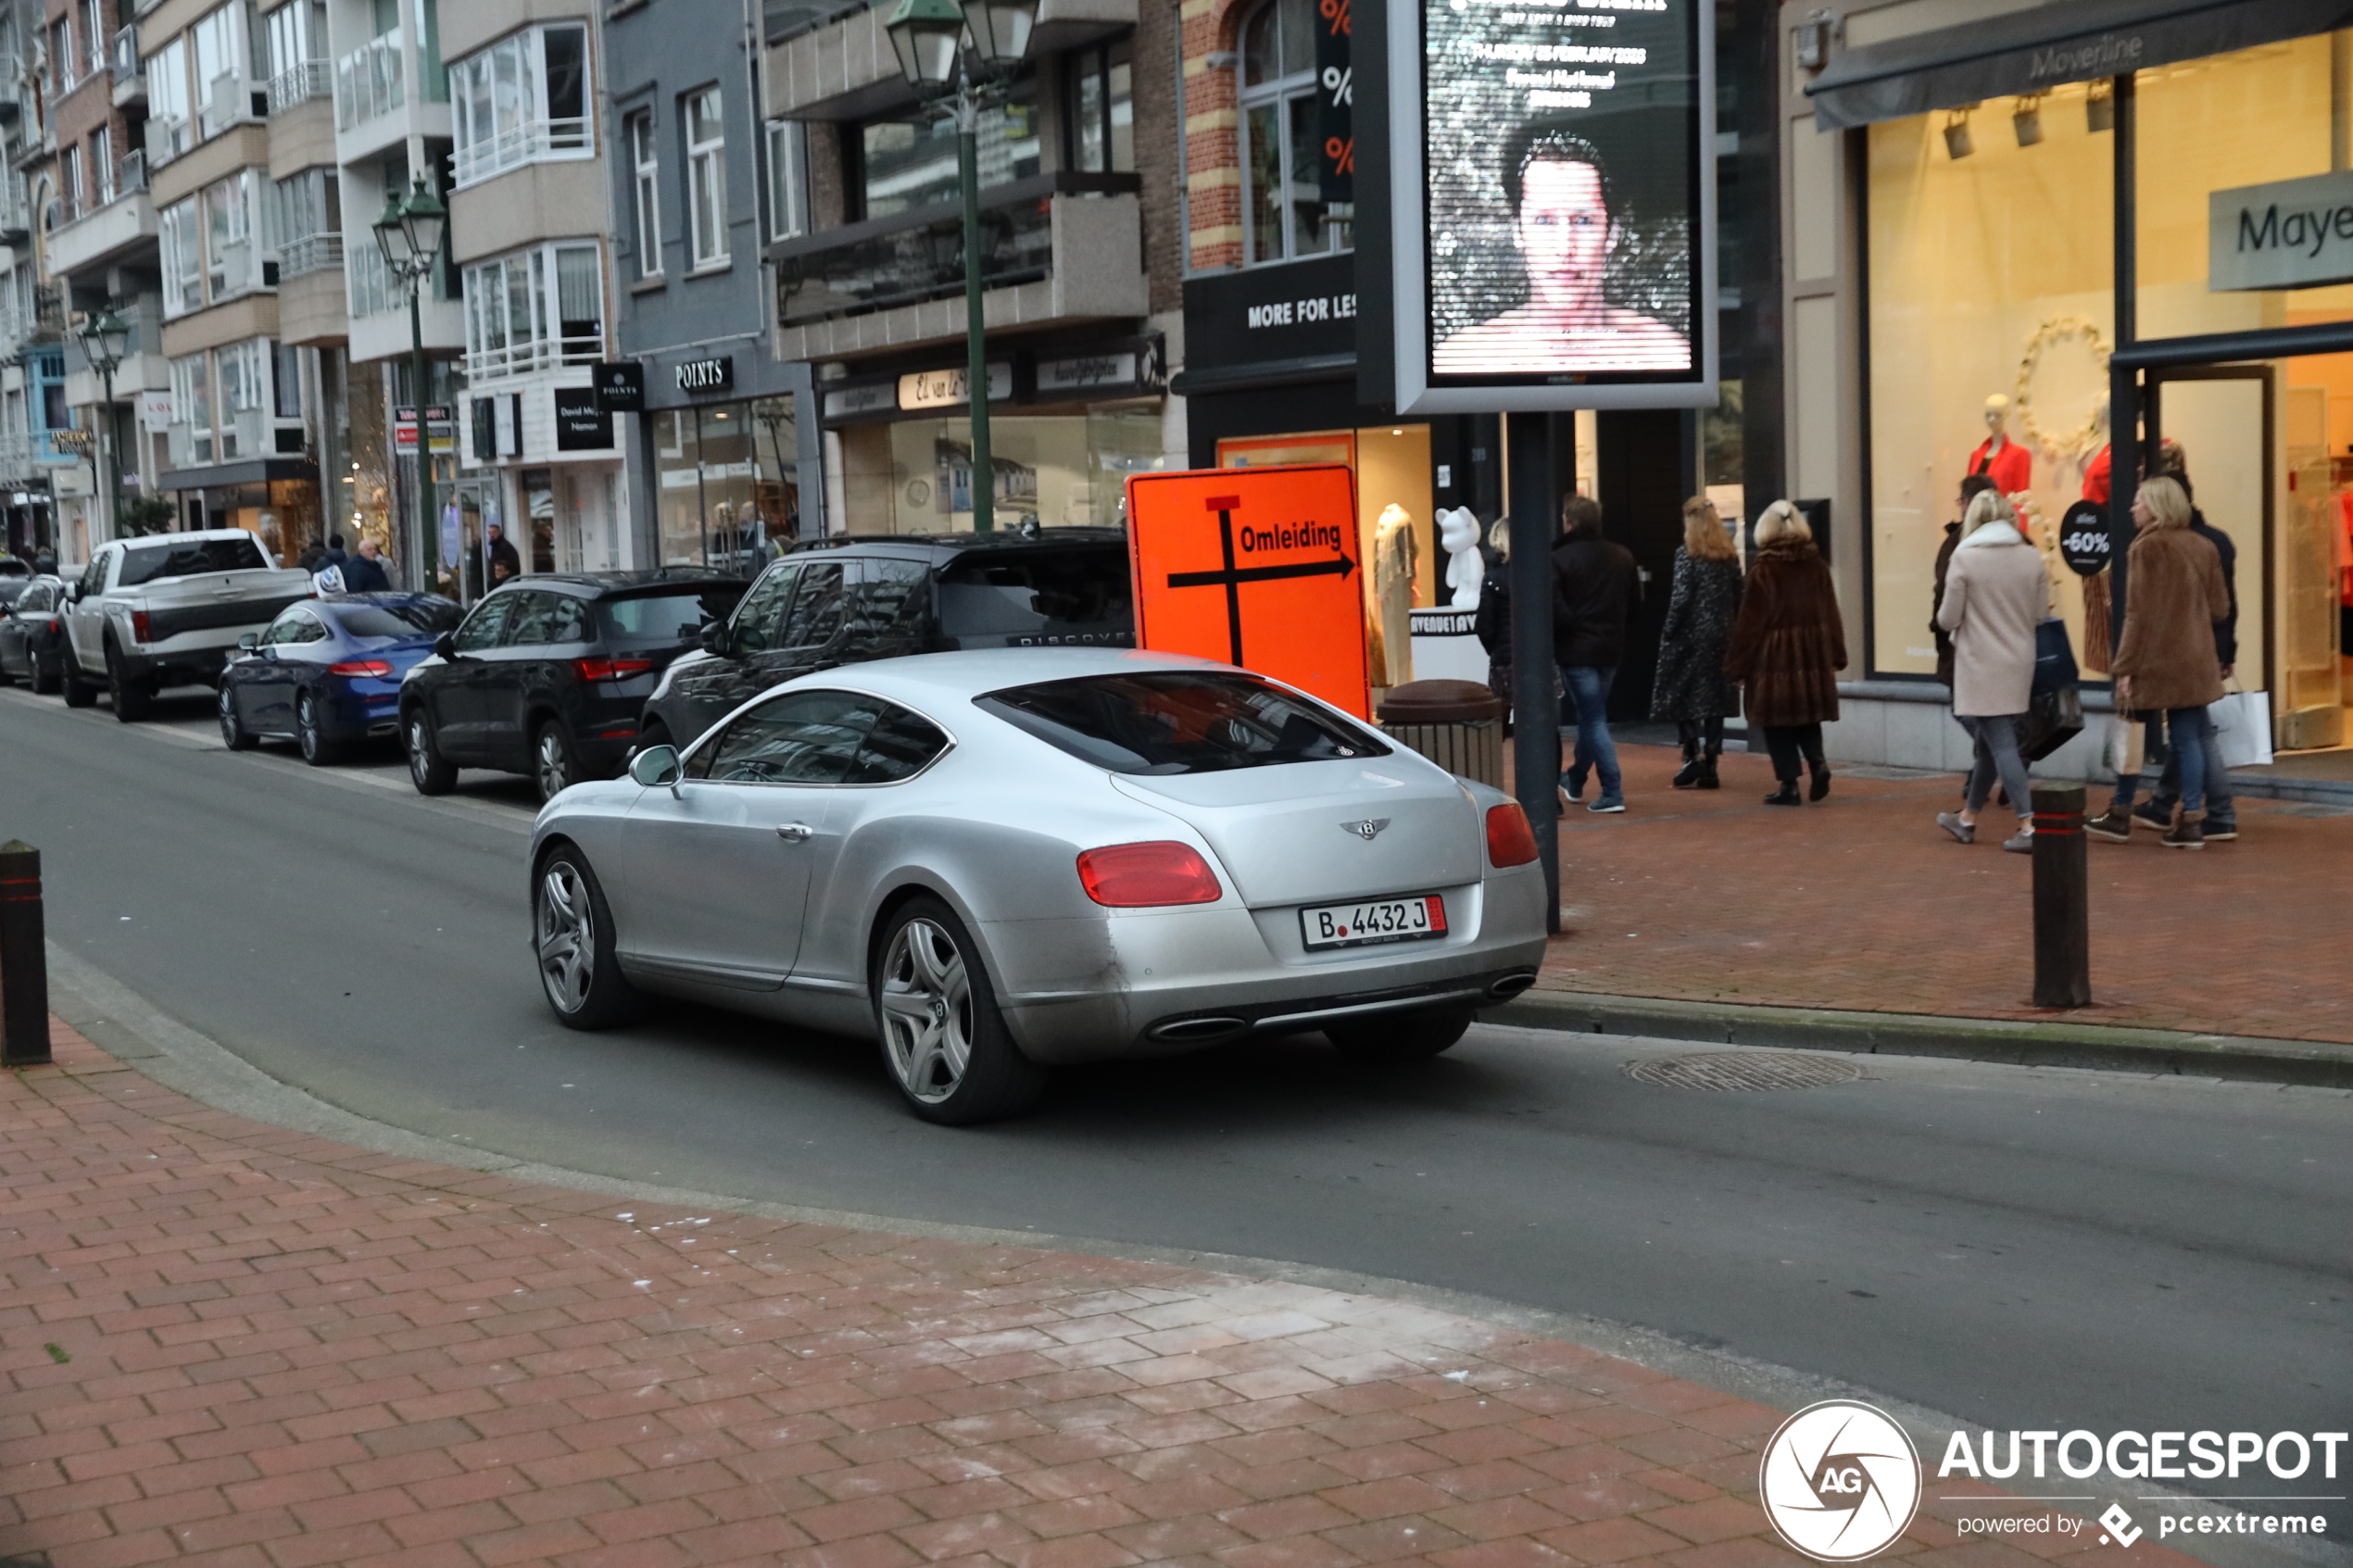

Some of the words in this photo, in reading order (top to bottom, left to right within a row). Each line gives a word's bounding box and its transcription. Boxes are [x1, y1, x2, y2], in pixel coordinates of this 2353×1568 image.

[2238, 203, 2353, 257] Maye
[1248, 302, 1292, 329] MORE
[1297, 297, 1328, 322] FOR
[675, 358, 723, 389] POINTS
[603, 387, 637, 395] POINTS
[560, 406, 582, 417] David
[1241, 521, 1341, 552] Omleiding
[2062, 531, 2109, 553] -60%
